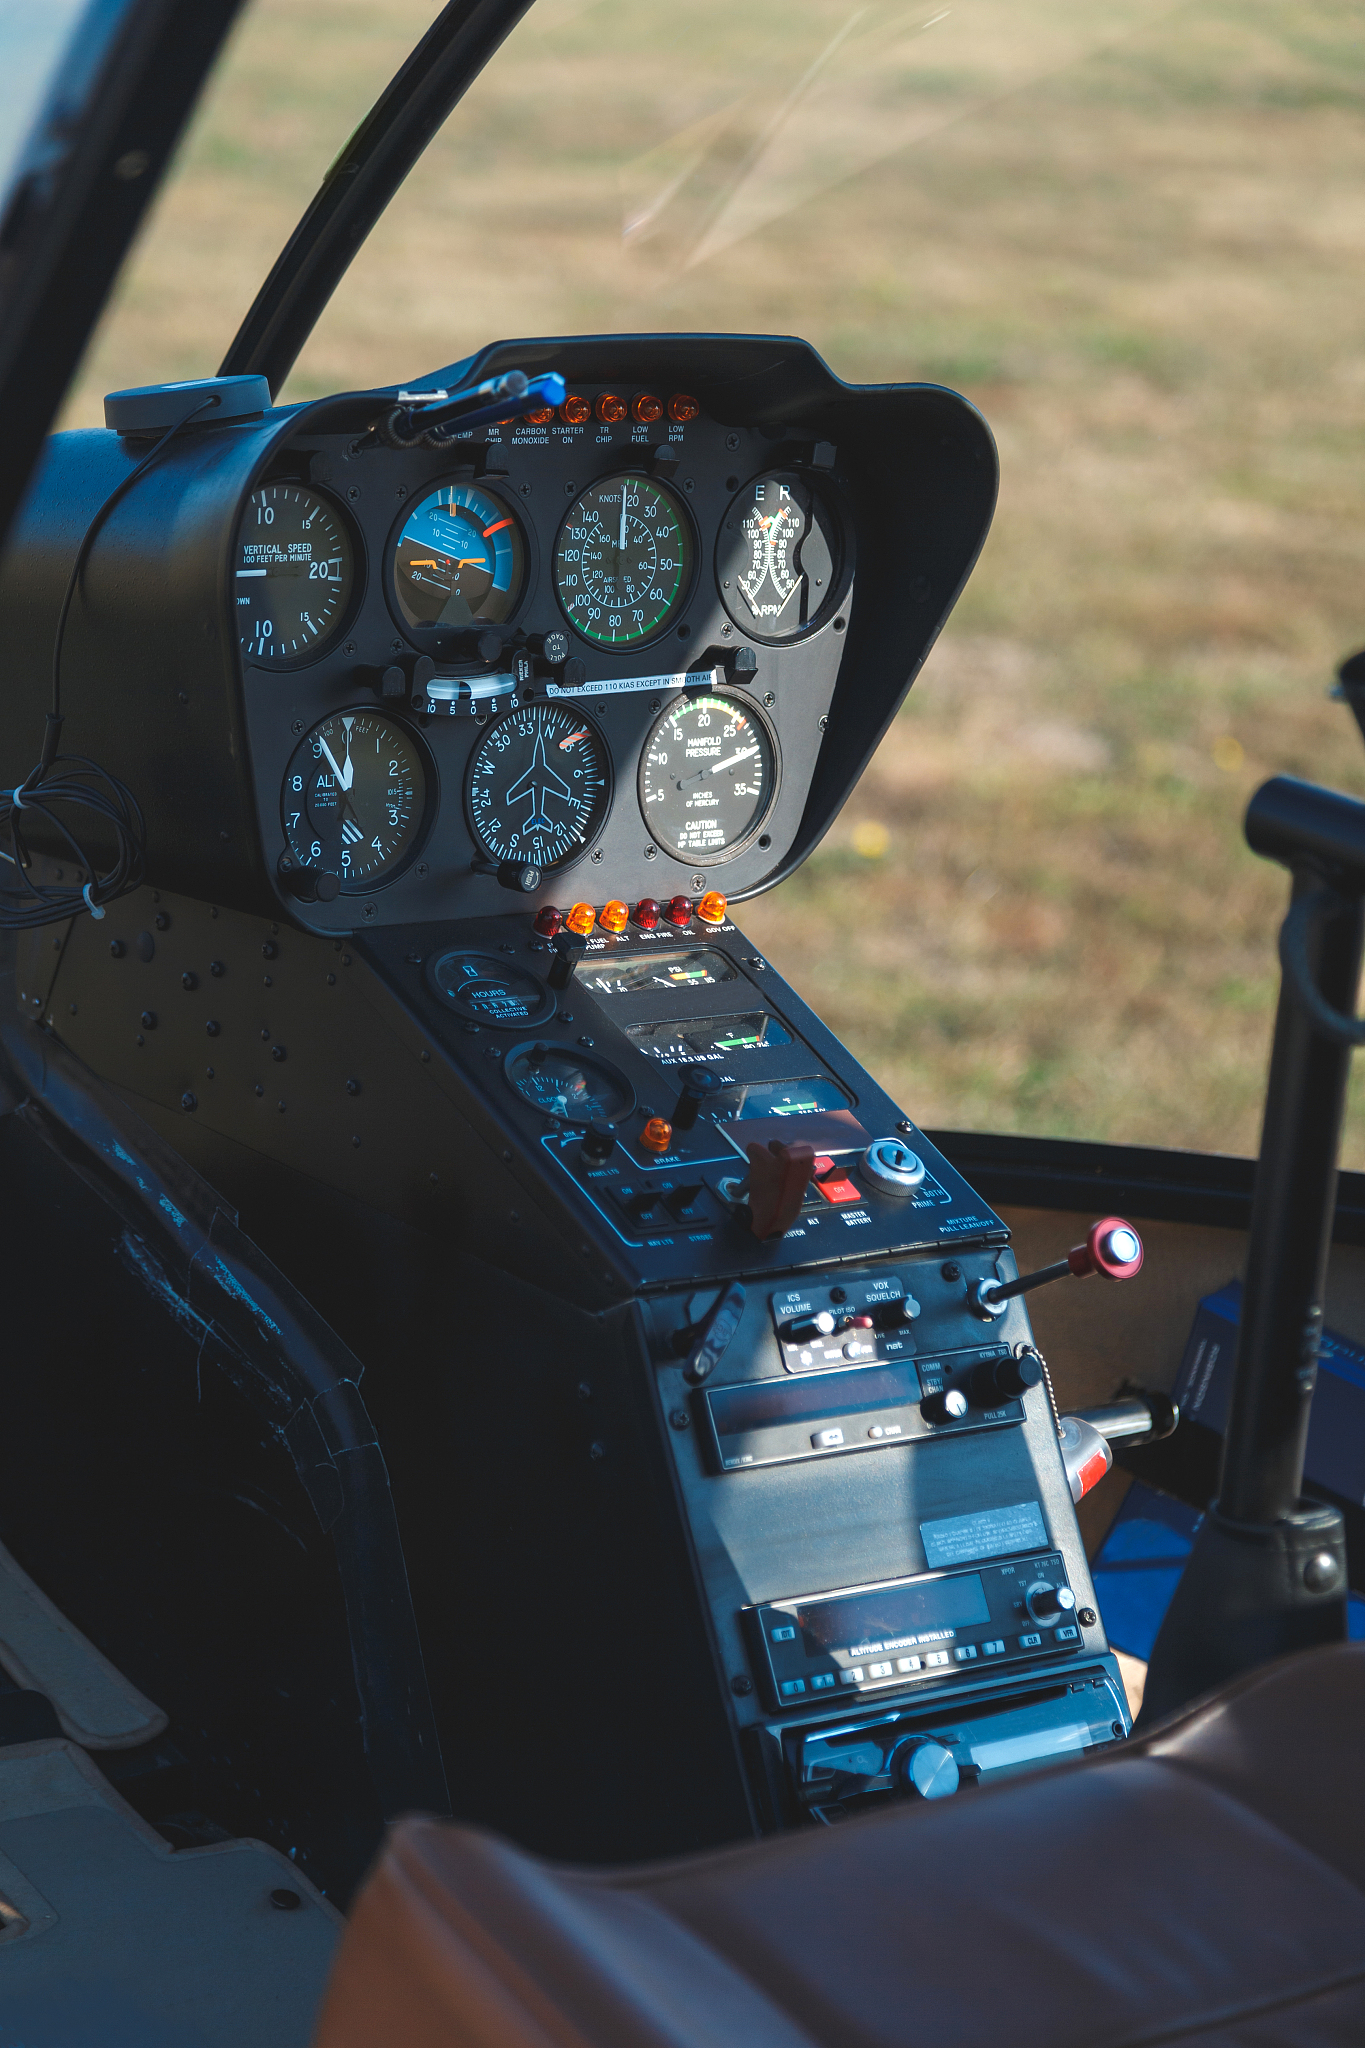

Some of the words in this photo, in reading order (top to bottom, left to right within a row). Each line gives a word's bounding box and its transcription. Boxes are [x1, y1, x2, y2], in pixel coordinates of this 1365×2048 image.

[600, 426, 610, 434] TR
[511, 436, 550, 444] MONOXIDE
[562, 436, 574, 444] ON
[596, 435, 612, 443] CHIP
[632, 434, 650, 442] FUEL
[668, 434, 684, 442] RPM
[756, 485, 765, 500] E
[780, 485, 790, 500] R
[599, 494, 622, 504] KNOTS
[626, 494, 640, 507] 20
[258, 507, 274, 525] 10
[429, 512, 438, 522] 20
[582, 511, 600, 523] 140
[644, 506, 658, 518] 30
[302, 520, 312, 530] 15
[743, 519, 754, 528] 110
[788, 518, 800, 528] 110
[571, 528, 587, 540] 130
[656, 526, 670, 538] 40
[748, 529, 759, 539] 100
[782, 528, 794, 538] 100
[600, 534, 610, 544] 160
[634, 535, 644, 544] 40
[754, 539, 762, 550] 90
[244, 544, 282, 556] VERTICAL
[288, 543, 312, 554] SPEED
[754, 550, 762, 560] 80
[243, 555, 254, 564] 100
[256, 554, 272, 564] FEET
[274, 554, 288, 562] PER
[290, 553, 312, 562] MINUTE
[564, 550, 580, 562] 120
[590, 552, 602, 560] 140
[638, 561, 648, 570] 60
[660, 558, 673, 571] 50
[308, 562, 328, 580] 20
[412, 570, 422, 581] 20
[592, 570, 604, 579] 120
[566, 574, 578, 586] 110
[604, 585, 615, 594] 100
[626, 584, 636, 593] 80
[650, 588, 663, 600] 60
[574, 594, 591, 606] 100
[300, 612, 310, 622] 15
[588, 608, 601, 620] 90
[632, 610, 644, 622] 70
[608, 614, 622, 627] 80
[256, 620, 273, 638] 10
[549, 687, 560, 695] DO
[578, 684, 603, 693] EXCEED
[636, 680, 662, 688] EXCEPT
[427, 704, 436, 714] 10
[450, 706, 456, 714] 5
[492, 704, 498, 712] 5
[510, 698, 518, 708] 10
[698, 714, 711, 727] 20
[356, 726, 370, 734] FEET
[518, 722, 534, 737] 33
[544, 724, 556, 740] N
[674, 728, 684, 740] 15
[724, 725, 736, 738] 25
[495, 734, 512, 753] 30
[687, 736, 722, 747] MANIFOLD
[312, 743, 322, 759] 9
[685, 746, 722, 758] PRESSURE
[658, 752, 668, 766] 10
[388, 760, 398, 776] 2
[482, 760, 496, 776] W
[574, 770, 584, 778] 6
[292, 775, 302, 792] 8
[316, 774, 337, 788] ALT
[657, 788, 664, 802] 5
[734, 783, 746, 796] 35
[480, 788, 492, 808] 24
[692, 791, 713, 800] INCHES
[568, 797, 582, 810] E
[694, 798, 720, 807] MERCURY
[290, 812, 300, 829] 7
[388, 810, 399, 826] 3
[488, 818, 502, 833] 21
[554, 821, 568, 837] 12
[685, 820, 718, 830] CAUTION
[680, 832, 688, 840] DO
[690, 831, 702, 840] NOT
[702, 830, 724, 838] EXCEED
[371, 836, 382, 851] 4
[510, 834, 520, 848] S
[532, 836, 544, 850] 15
[688, 840, 707, 848] TABLE
[708, 838, 726, 846] LIMITS
[310, 840, 322, 857] 6
[341, 850, 352, 867] 5
[472, 990, 506, 998] HOURS
[489, 1006, 528, 1014] COLLECTIVE
[496, 1011, 529, 1019] ACTIVATED
[654, 1156, 681, 1164] BRAKE
[924, 1190, 945, 1198] BOTH
[912, 1200, 936, 1208] PRIME
[840, 1211, 867, 1220] MASTER
[946, 1216, 978, 1225] MIXTURE
[807, 1217, 820, 1226] ALT
[844, 1217, 872, 1226] BATTERY
[960, 1220, 994, 1230] LEAN/OFF
[873, 1282, 890, 1290] VOX
[788, 1294, 800, 1302] ICS
[866, 1290, 901, 1302] SQUELCH
[780, 1303, 812, 1314] VOLUME
[886, 1342, 904, 1351] nat
[922, 1362, 942, 1372] COMM
[927, 1378, 942, 1387] STBY/
[928, 1385, 944, 1394] CHAN
[984, 1412, 997, 1420] PULL
[1001, 1567, 1016, 1576] XPDR
[851, 1642, 884, 1656] ALTITUDE
[884, 1637, 917, 1651] ENCODER
[918, 1630, 954, 1645] INSTALLED
